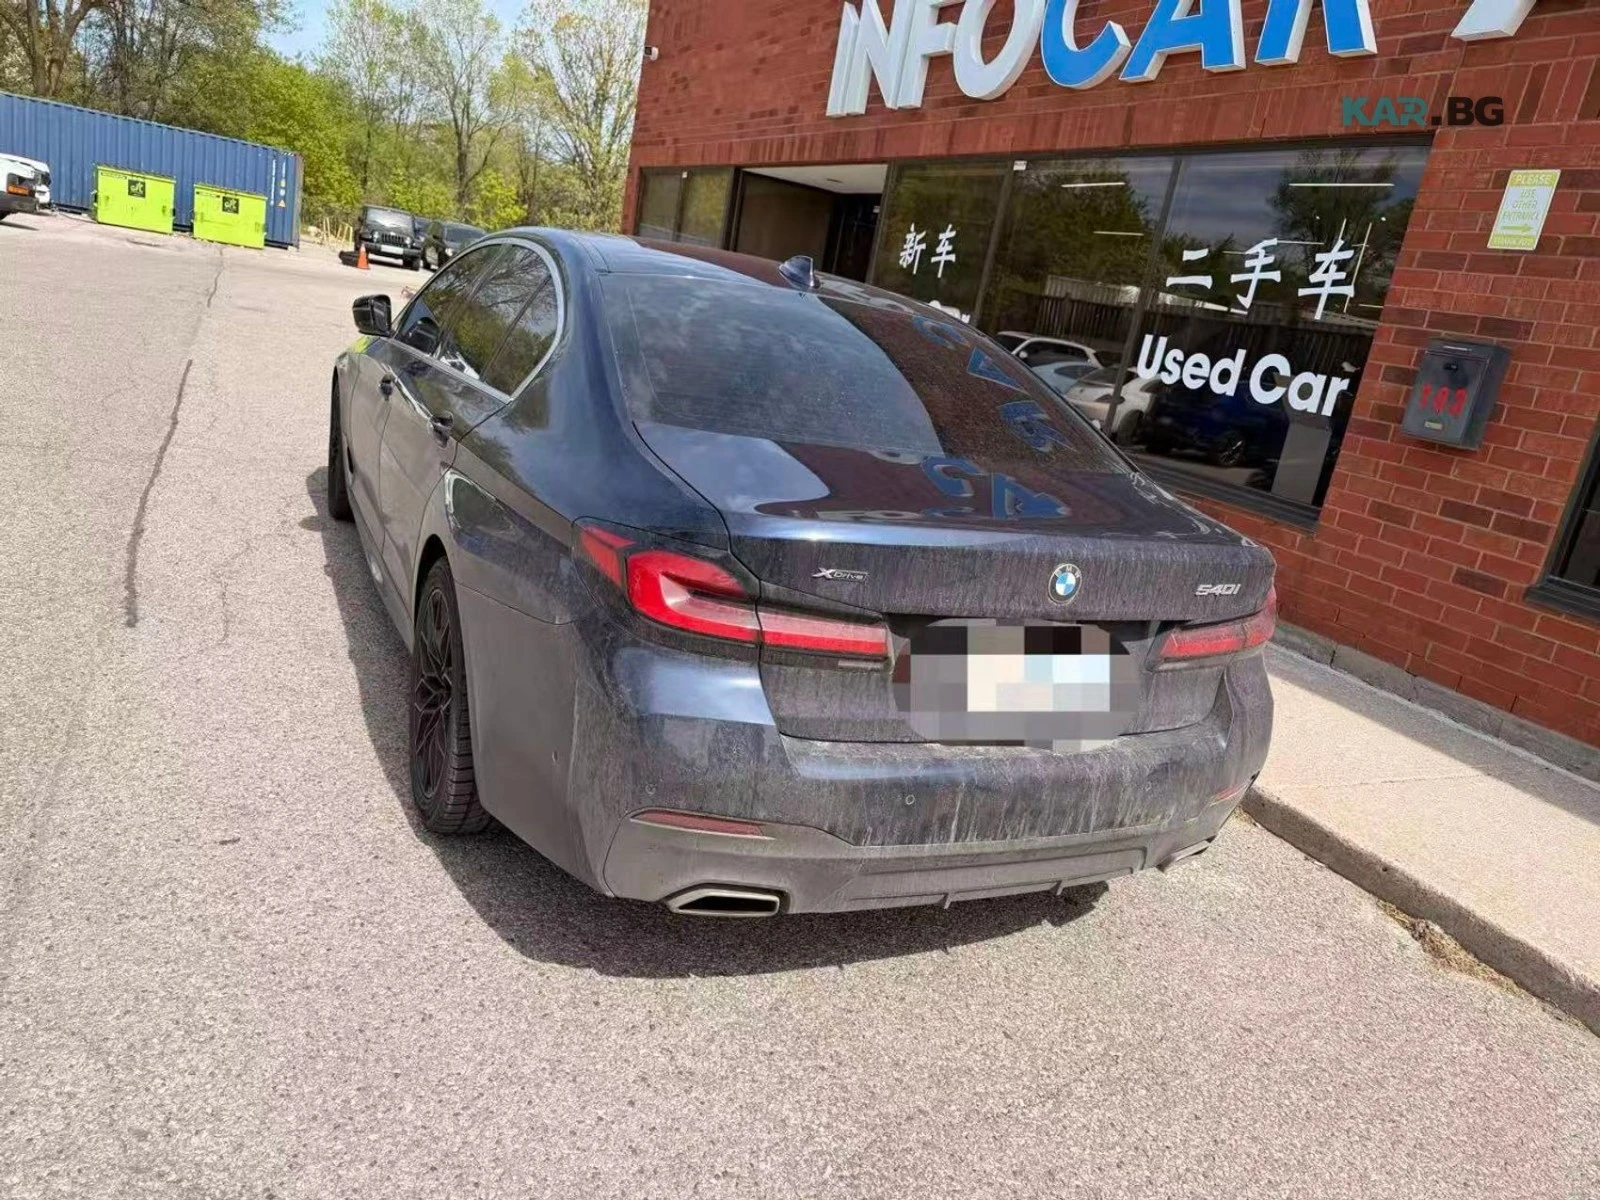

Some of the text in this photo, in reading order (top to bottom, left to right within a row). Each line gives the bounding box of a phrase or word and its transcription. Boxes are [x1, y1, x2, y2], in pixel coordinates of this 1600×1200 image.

[1513, 173, 1552, 186] PLEASE
[899, 223, 957, 278] 新车
[1166, 238, 1355, 320] 二手车
[1137, 334, 1350, 417] Used Car
